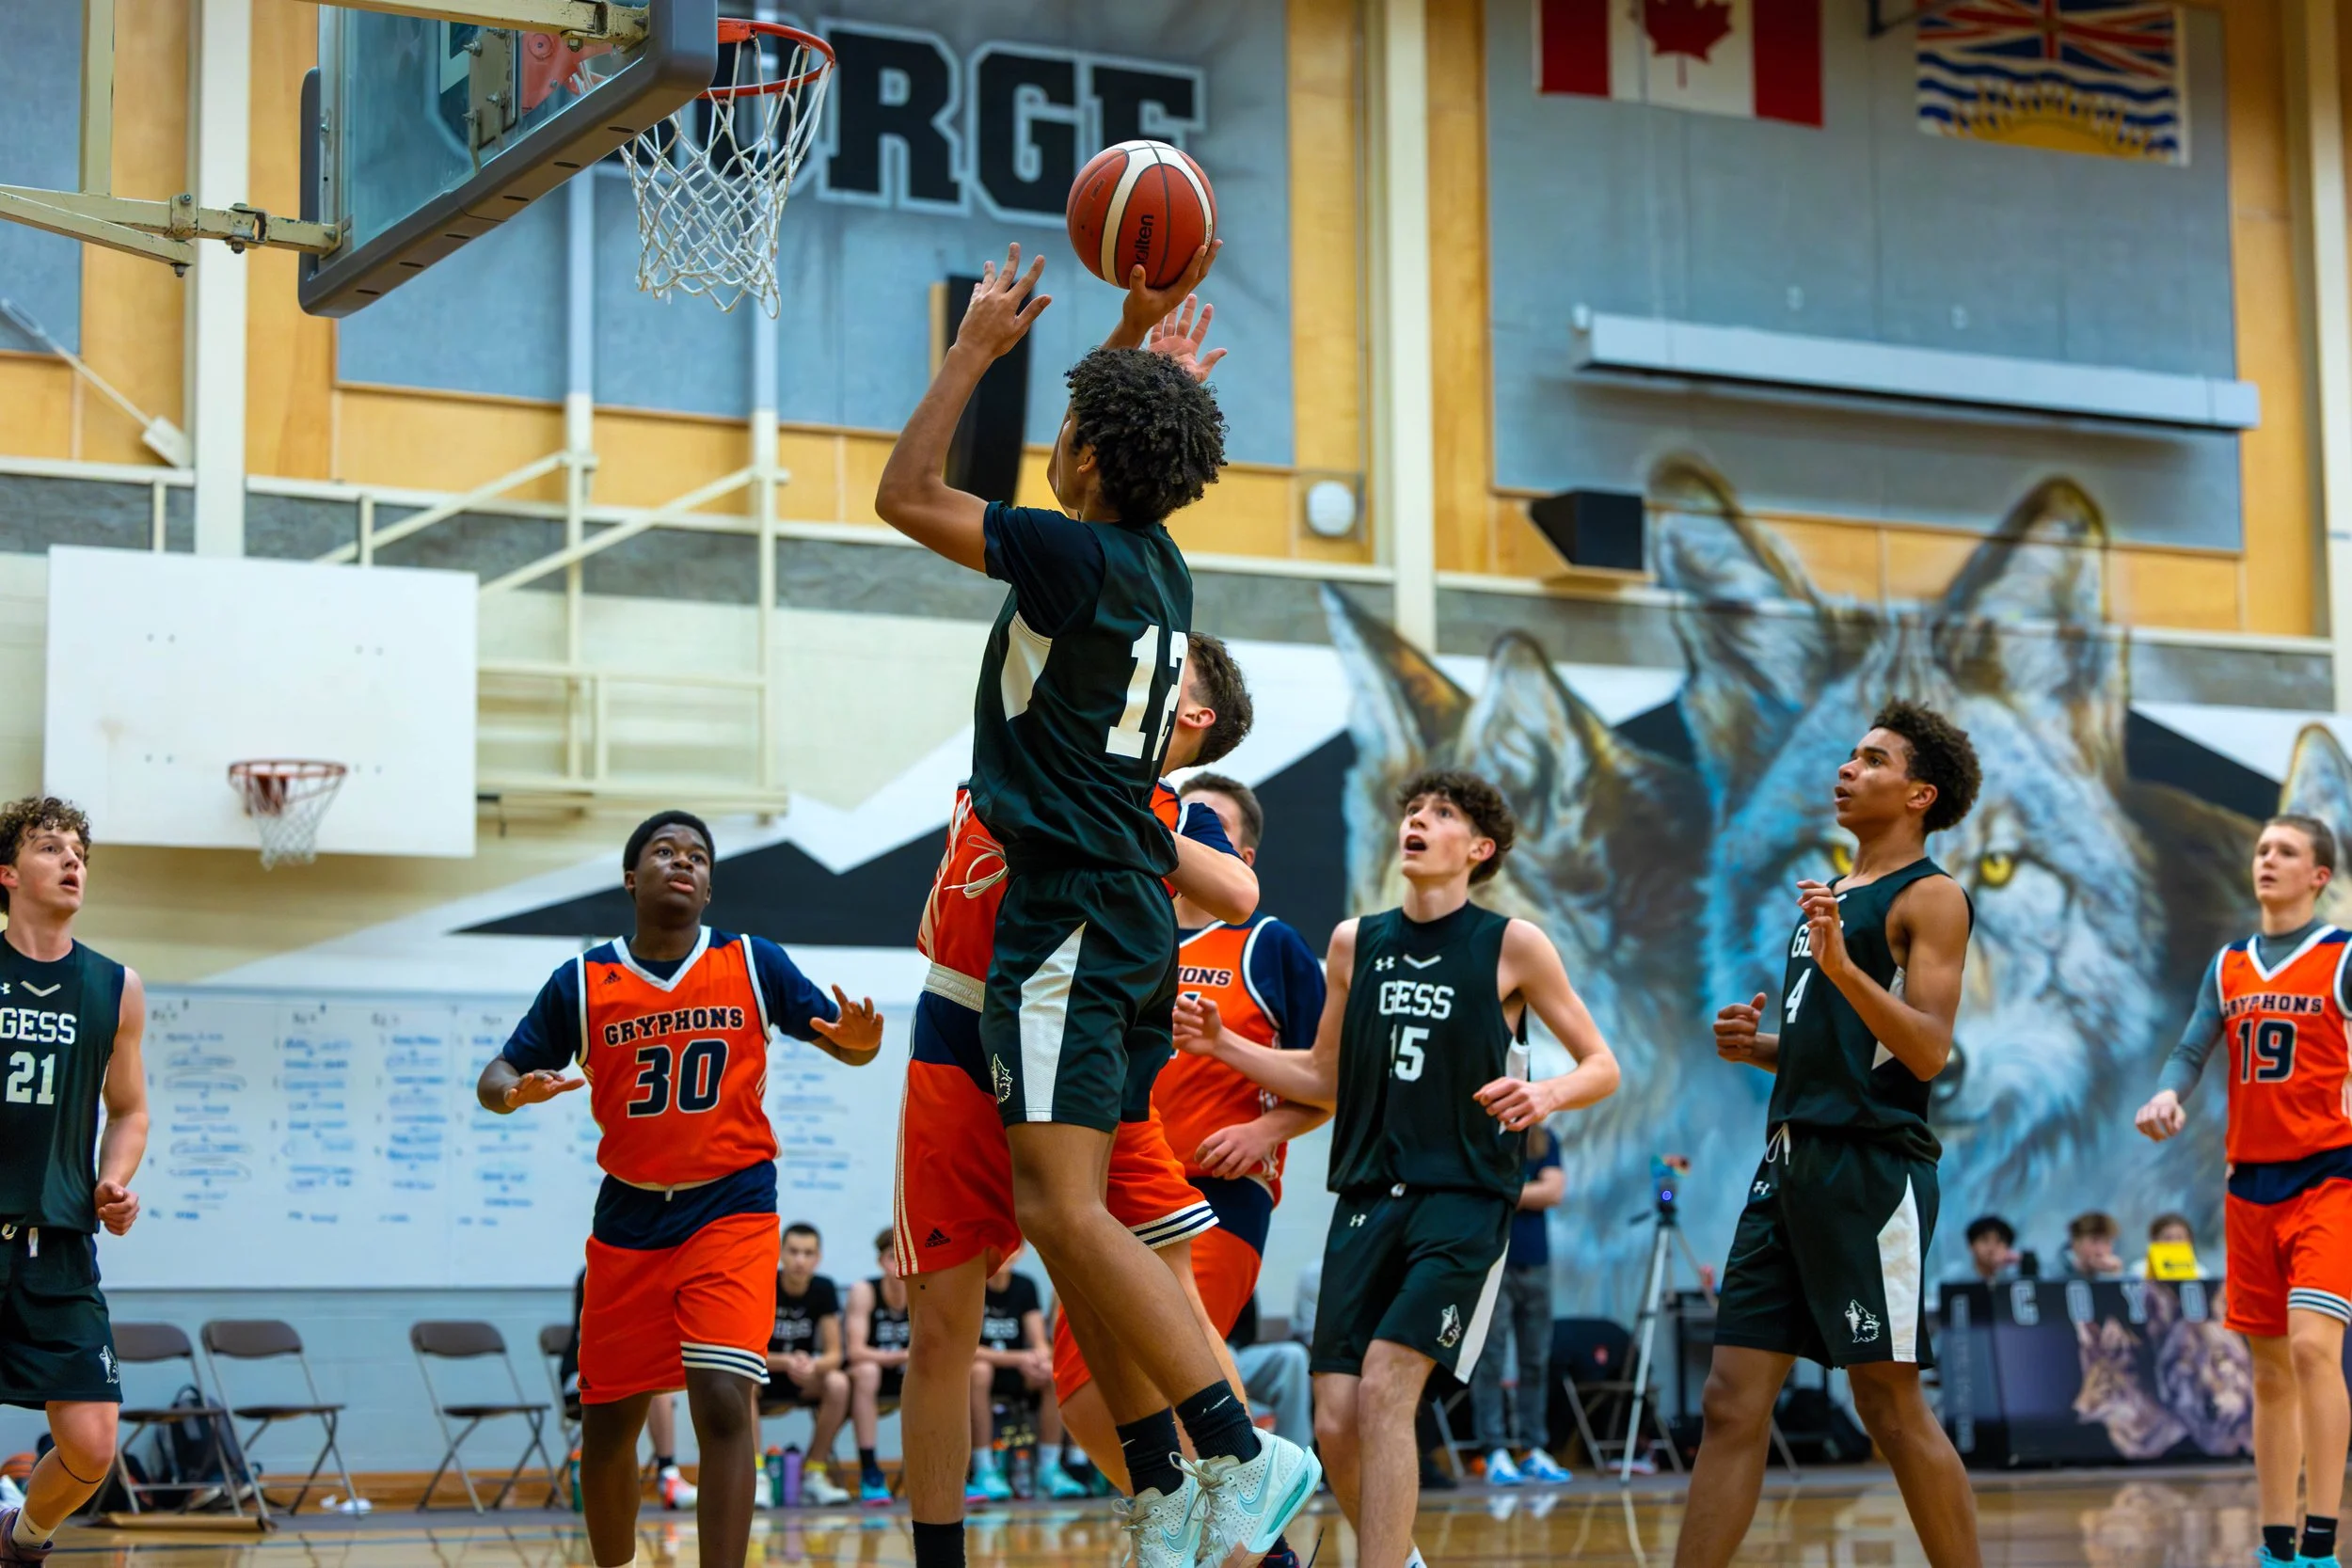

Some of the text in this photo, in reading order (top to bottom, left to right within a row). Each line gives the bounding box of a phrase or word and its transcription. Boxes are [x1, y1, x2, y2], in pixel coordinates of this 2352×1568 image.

[1134, 214, 1154, 264] olten
[1379, 980, 1454, 1020] GESS
[1786, 968, 1812, 1023] 4
[0, 1007, 77, 1045] GESS
[603, 1006, 745, 1046] GRYPHONS
[2237, 1019, 2297, 1084] 19
[6, 1051, 56, 1104] 21
[628, 1038, 729, 1117] 30
